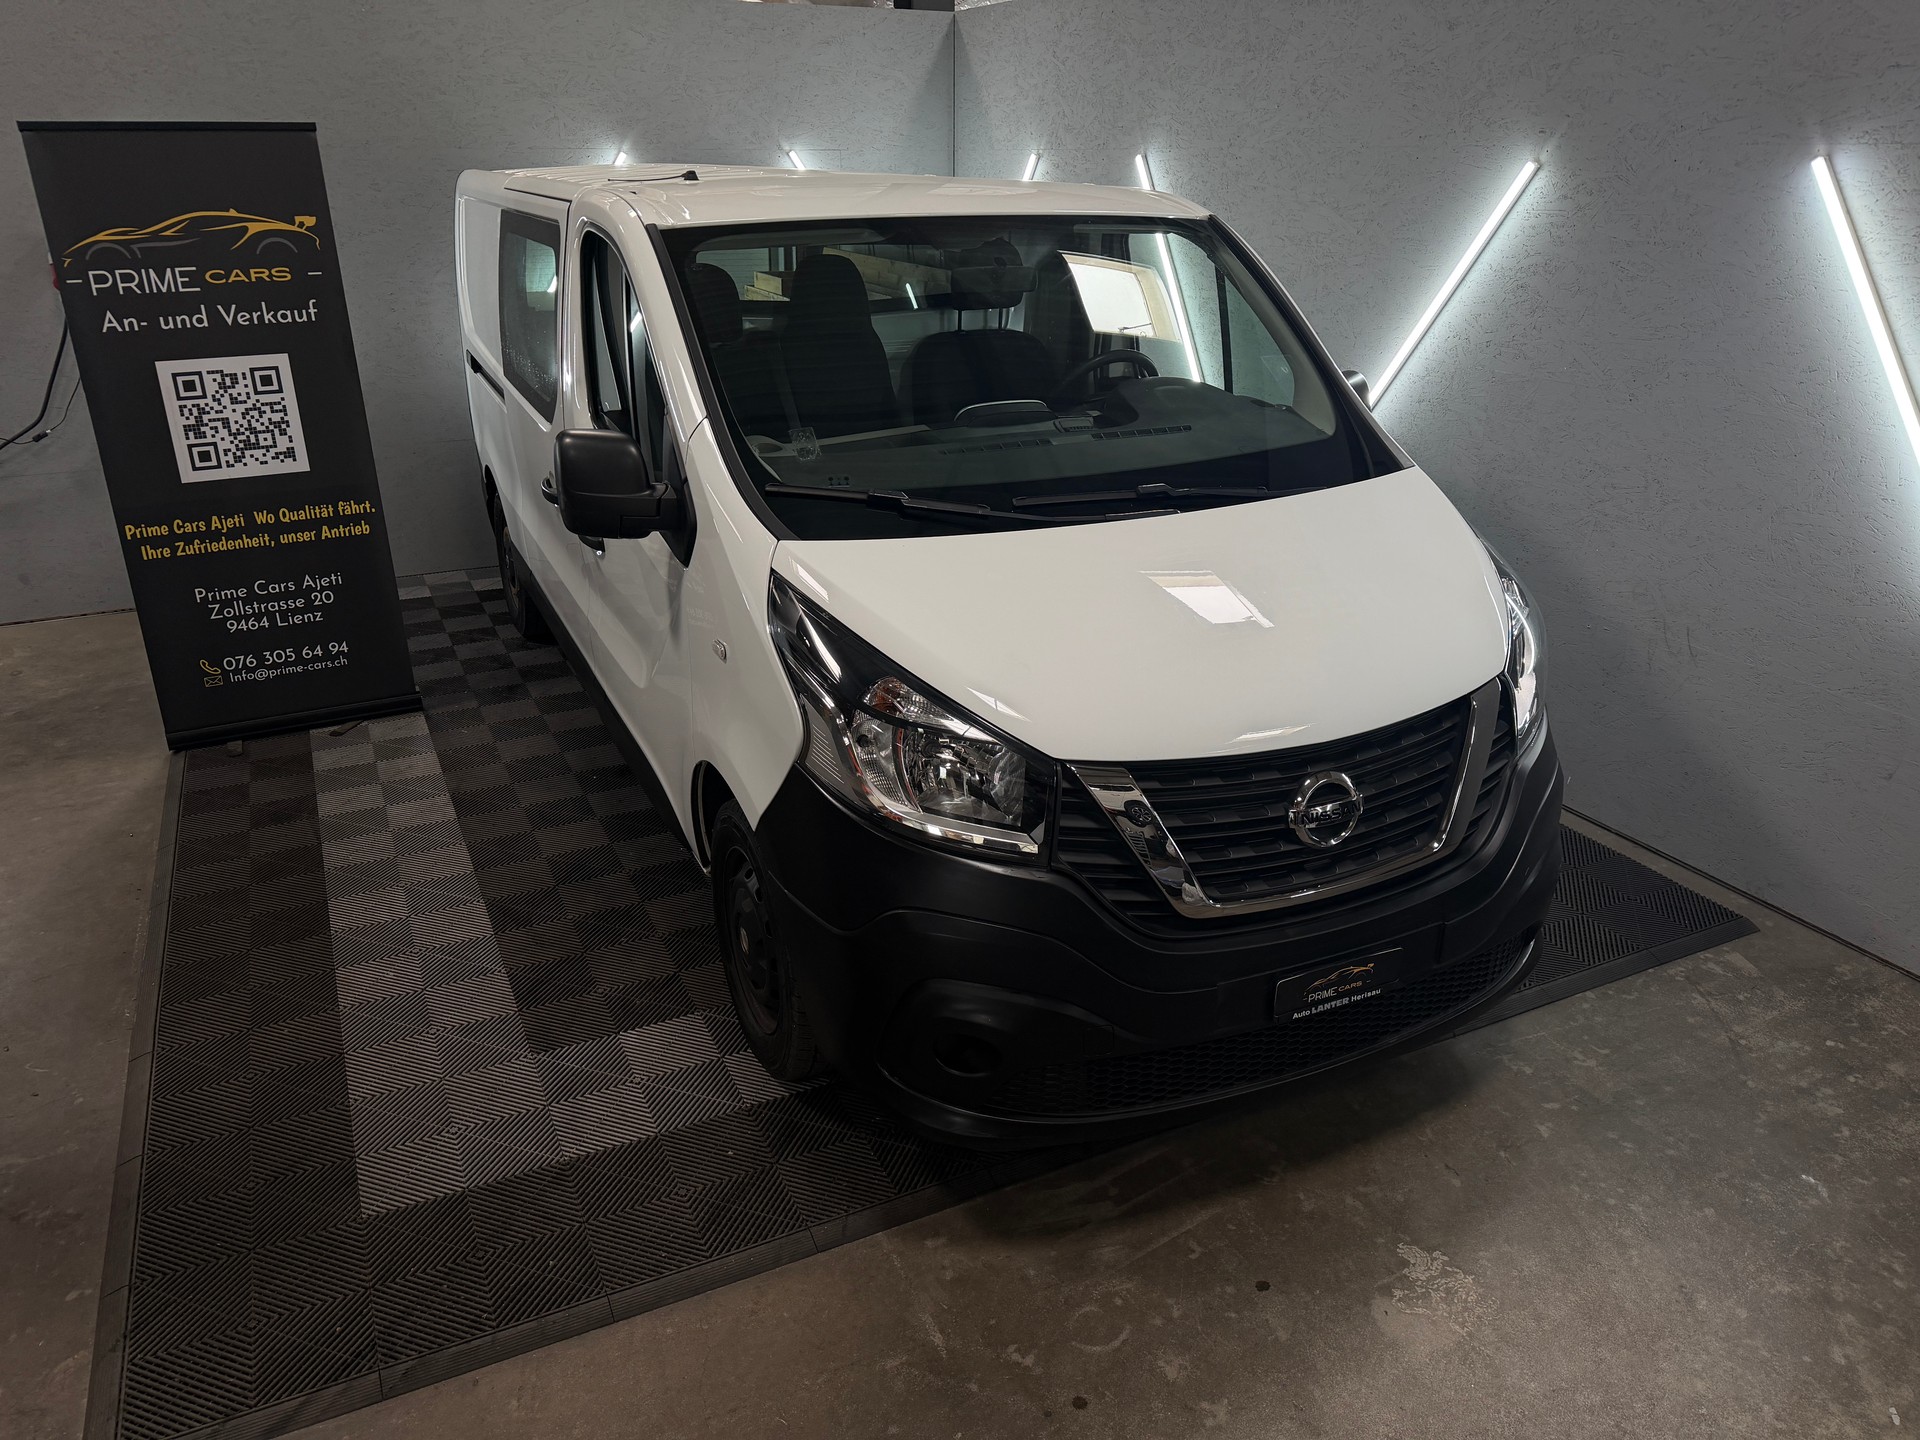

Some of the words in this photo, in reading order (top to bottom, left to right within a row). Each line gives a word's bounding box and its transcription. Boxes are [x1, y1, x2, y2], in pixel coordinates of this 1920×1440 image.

[88, 266, 201, 296] PRIME
[204, 267, 292, 284] CARS
[102, 310, 148, 333] An-
[159, 304, 209, 330] und
[216, 299, 318, 326] Verkauf
[124, 524, 169, 540] Prime
[173, 518, 206, 534] Cars
[211, 513, 245, 534] Ajeti
[254, 510, 275, 525] Wo
[279, 503, 334, 523] Qualität
[338, 500, 376, 518] fährt.
[141, 545, 171, 561] Ihre
[175, 533, 275, 557] Zufriedenheit,
[279, 529, 316, 545] unser
[321, 521, 371, 540] Antrieb
[194, 586, 247, 603] Prime
[254, 579, 296, 596] Cars
[302, 572, 342, 592] Ajeti
[208, 597, 305, 620] Zollstrasse
[311, 590, 334, 607] 20
[226, 616, 270, 633] 9464
[275, 610, 324, 627] Lienz
[223, 654, 257, 671] 076
[263, 648, 296, 665] 305
[302, 643, 323, 660] 64
[328, 640, 349, 656] 94
[229, 655, 348, 683] Info@prime-cars.ch
[1301, 800, 1361, 826] NISSAN
[1292, 1009, 1311, 1020] Auto
[1311, 996, 1350, 1014] LANTER
[1350, 988, 1381, 1002] Herisau
[1308, 986, 1339, 1003] PRIME
[1338, 980, 1363, 992] CARS
